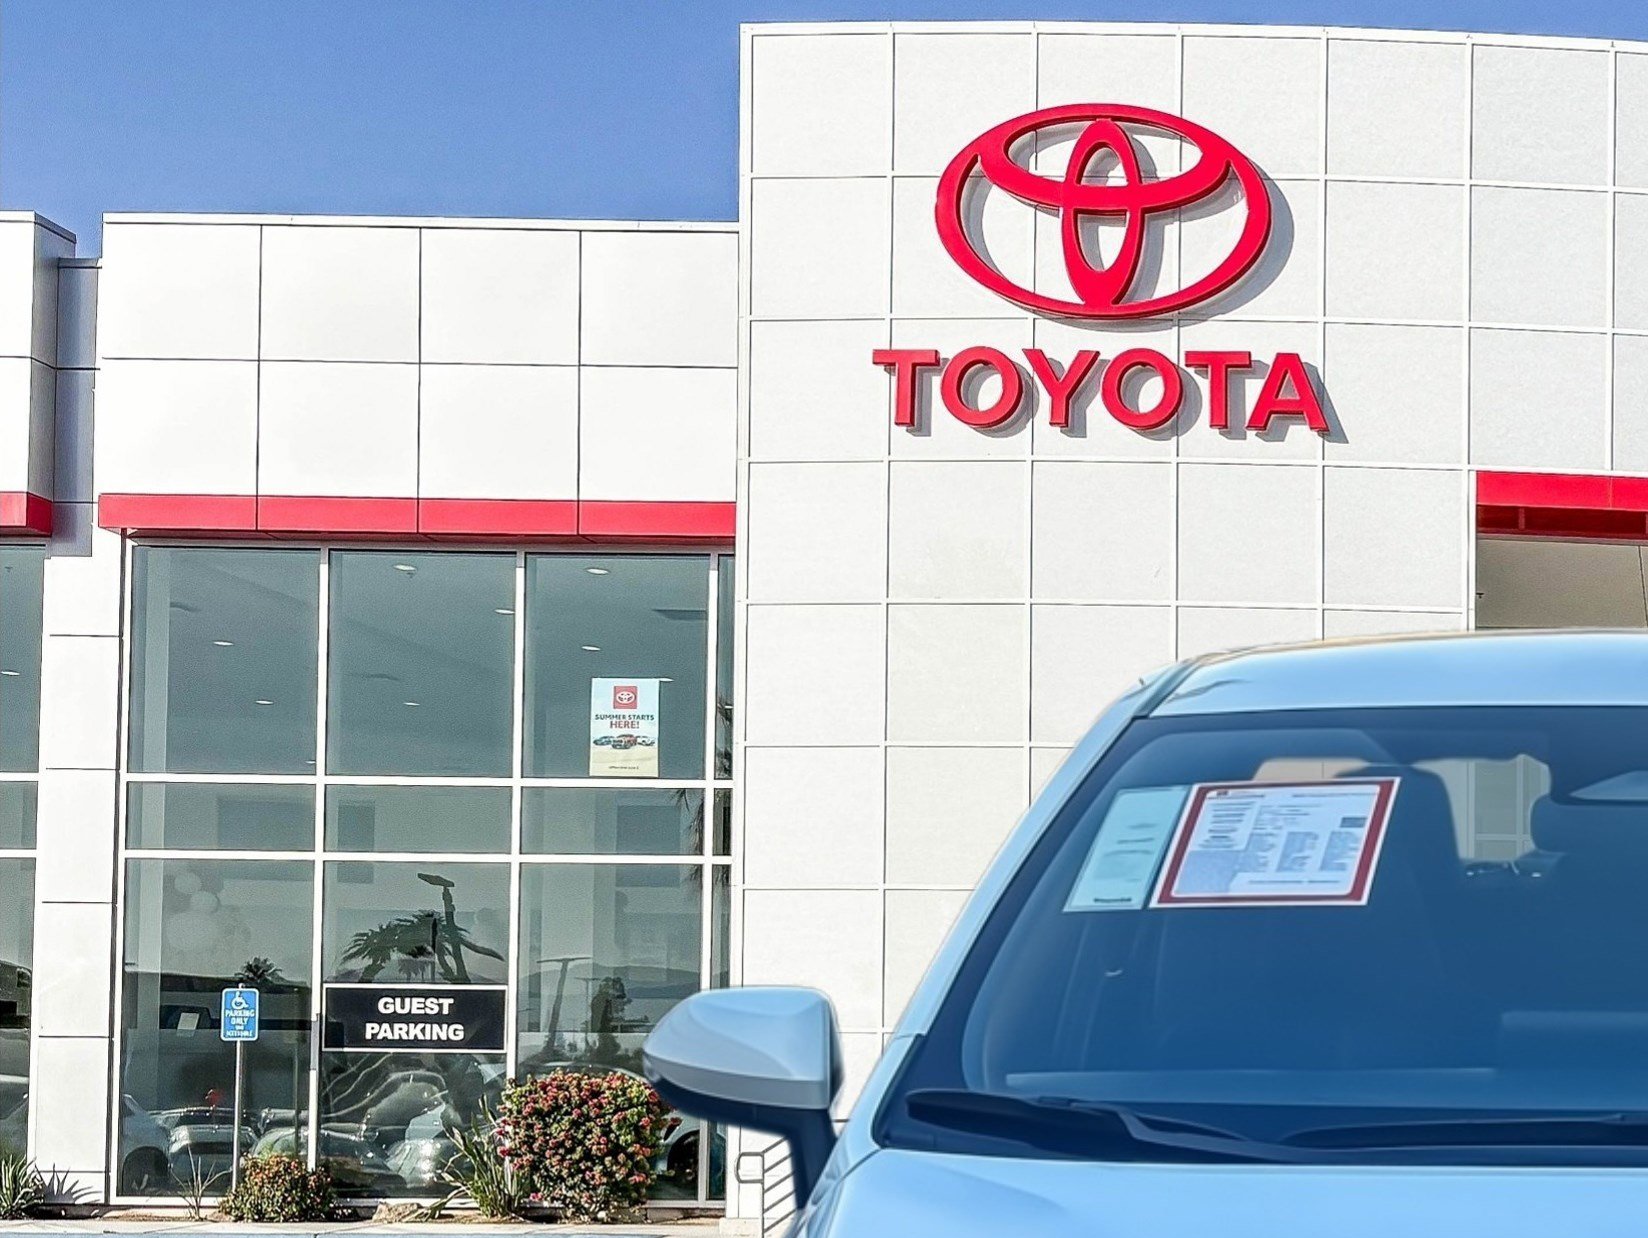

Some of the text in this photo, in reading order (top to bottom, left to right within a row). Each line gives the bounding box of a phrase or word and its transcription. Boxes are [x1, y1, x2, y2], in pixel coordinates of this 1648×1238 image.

[872, 345, 1329, 432] TOYOTA
[609, 720, 640, 729] HERE!
[377, 997, 455, 1015] GUEST
[225, 1009, 255, 1018] PARKING
[230, 1017, 249, 1025] ONLY
[365, 1022, 465, 1041] PARKING
